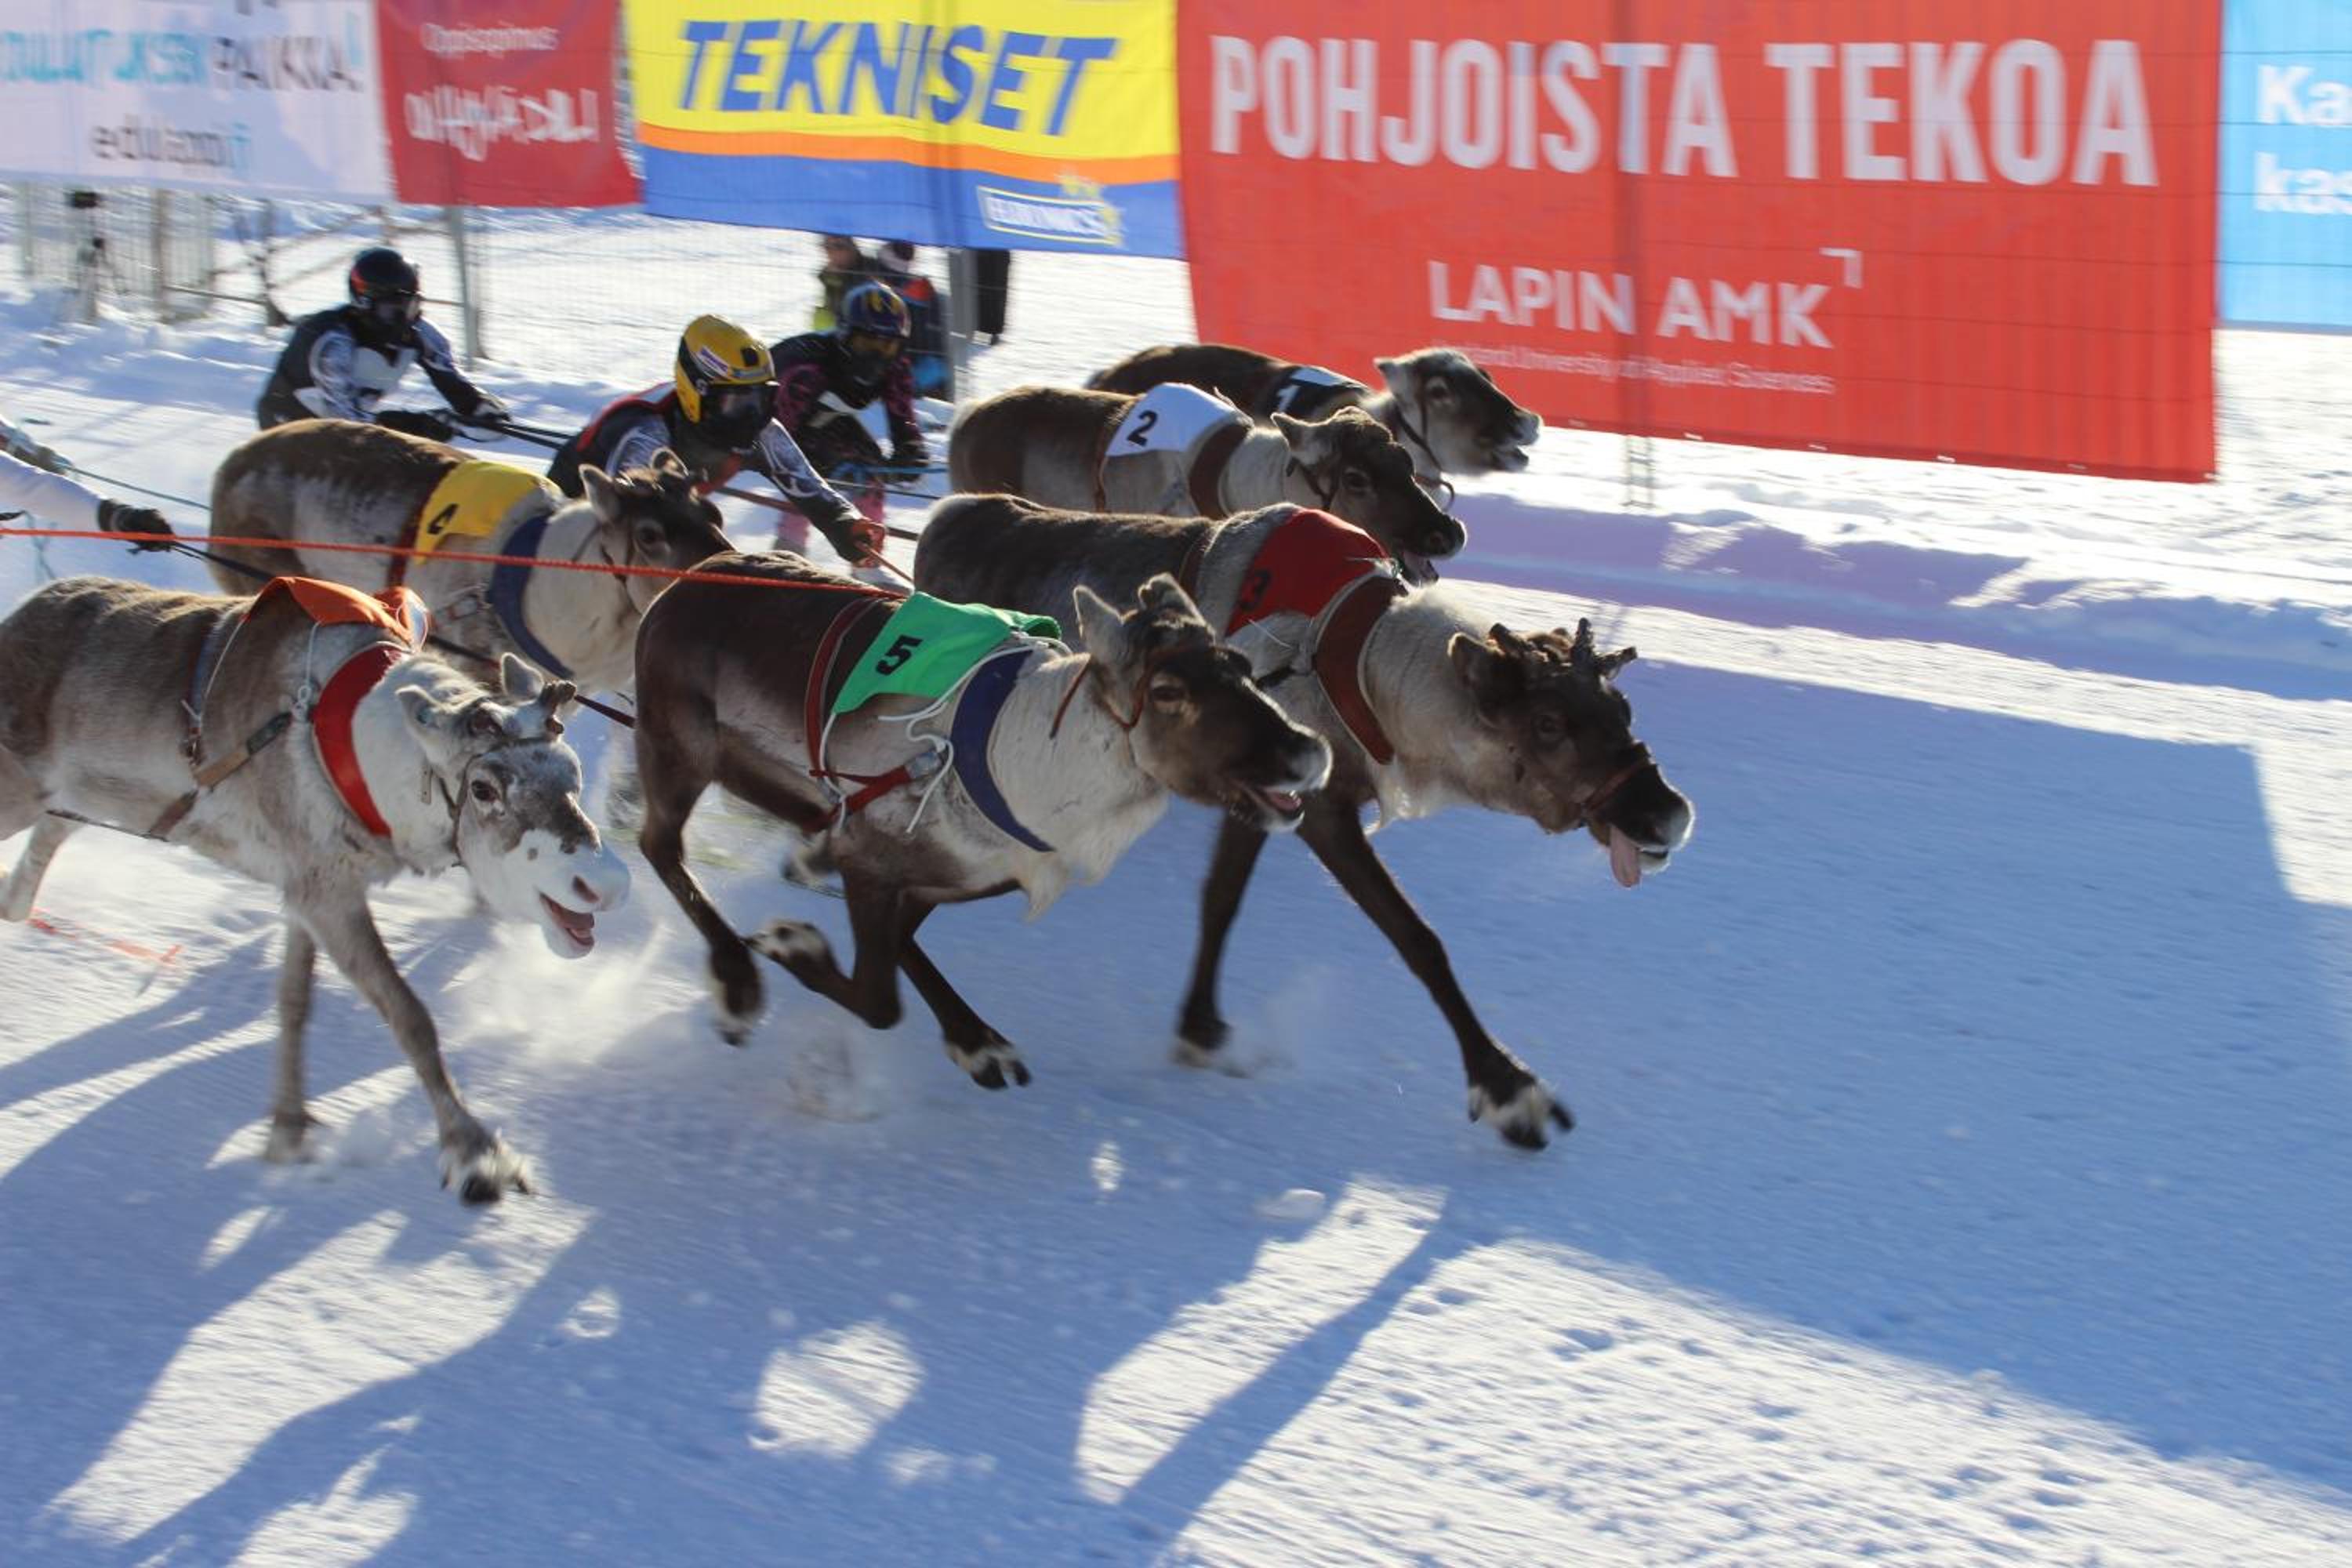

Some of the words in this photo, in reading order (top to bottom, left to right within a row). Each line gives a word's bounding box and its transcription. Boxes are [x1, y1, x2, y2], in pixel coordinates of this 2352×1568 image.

[679, 19, 1120, 136] TEKNISET
[1209, 34, 1740, 177] POHJOISTA
[1764, 38, 2160, 187] TEKOA
[1427, 260, 1637, 336] LAPIN
[1655, 276, 1835, 350] AMK
[1127, 410, 1158, 447] 2
[426, 503, 459, 535] 4
[875, 635, 923, 676] 5
